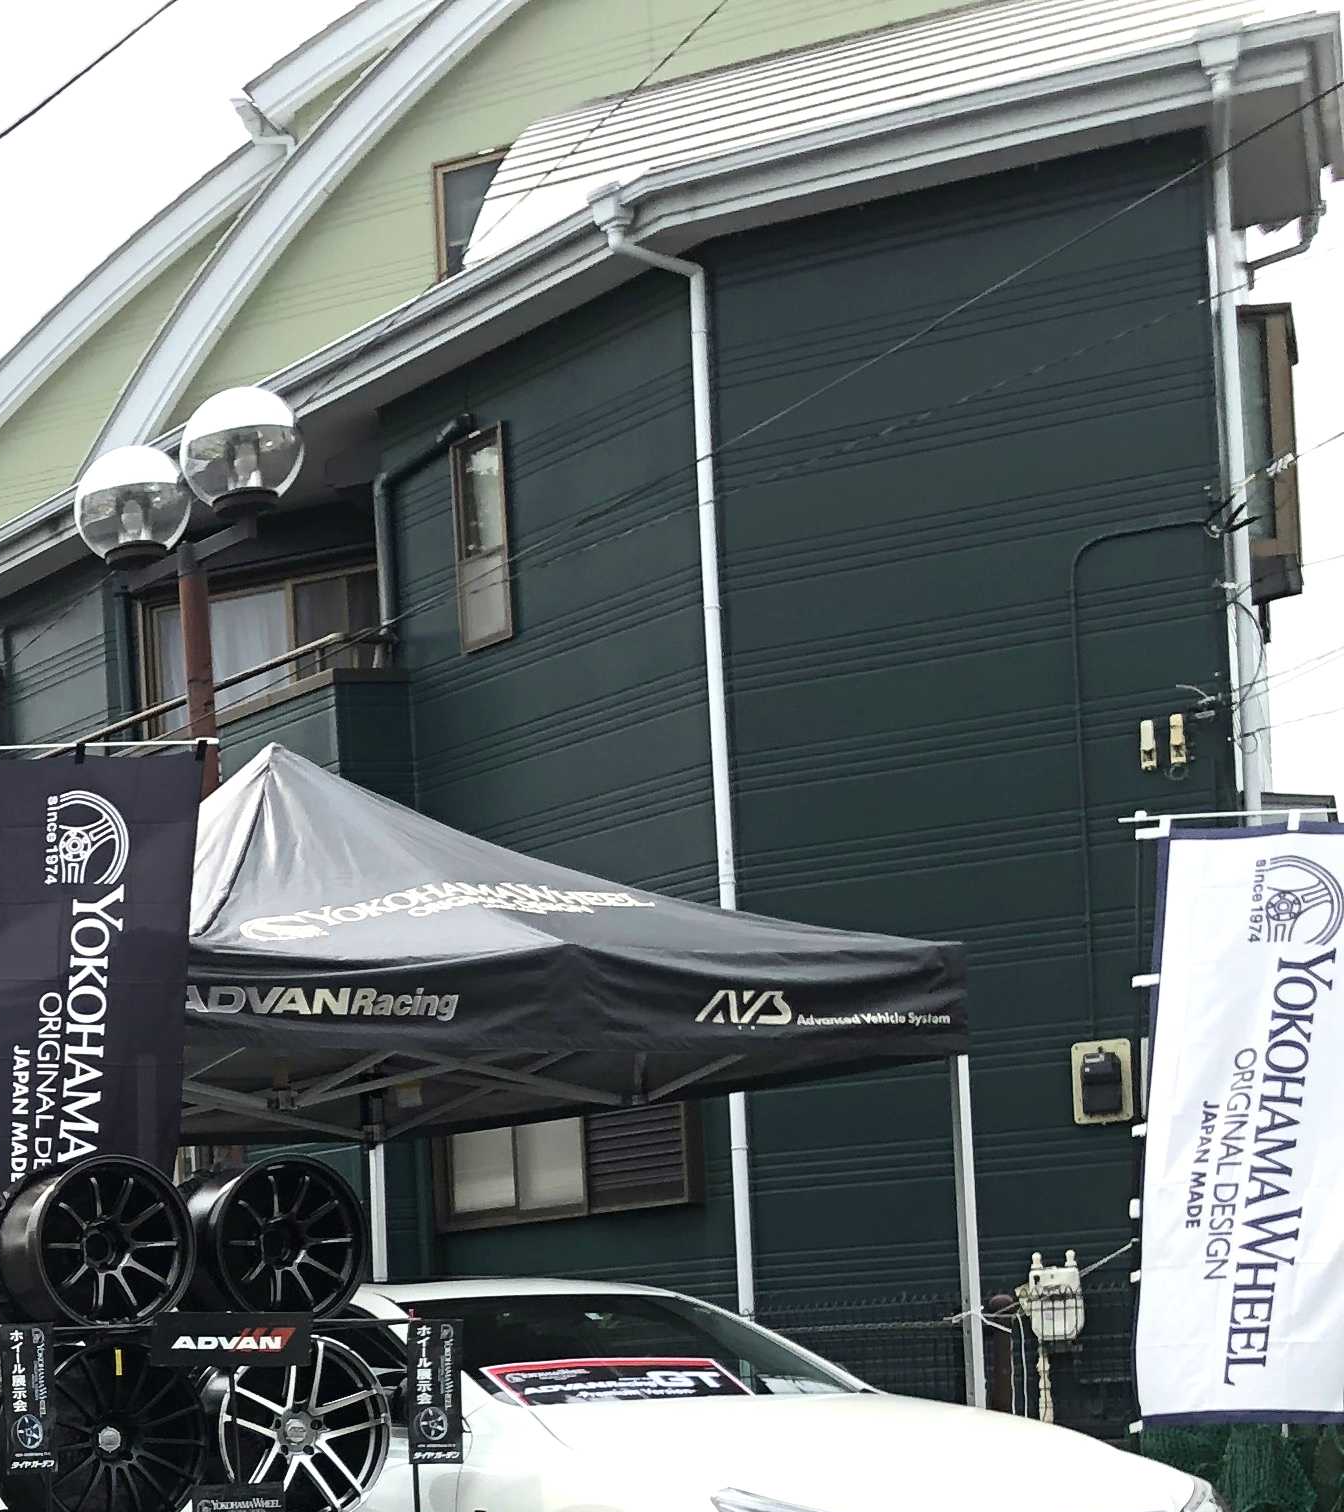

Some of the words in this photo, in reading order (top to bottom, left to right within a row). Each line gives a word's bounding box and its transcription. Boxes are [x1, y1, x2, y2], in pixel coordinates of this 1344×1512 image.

[46, 796, 58, 843] since
[44, 847, 58, 885] 1974
[1247, 909, 1263, 943] 1974
[907, 1011, 951, 1026] System
[12, 1045, 31, 1115] JAPAN
[35, 991, 63, 1129] ORIGINAL
[1192, 1099, 1219, 1167] JAPAN
[1213, 1048, 1257, 1178] ORIGINAL
[1185, 1170, 1206, 1230] MADE
[1204, 1184, 1236, 1281] DESIGN
[9, 1329, 28, 1413] ホイール展示会
[170, 1335, 282, 1350] ADVAN
[416, 1325, 433, 1405] ホイール展示会
[646, 1370, 721, 1388] GT
